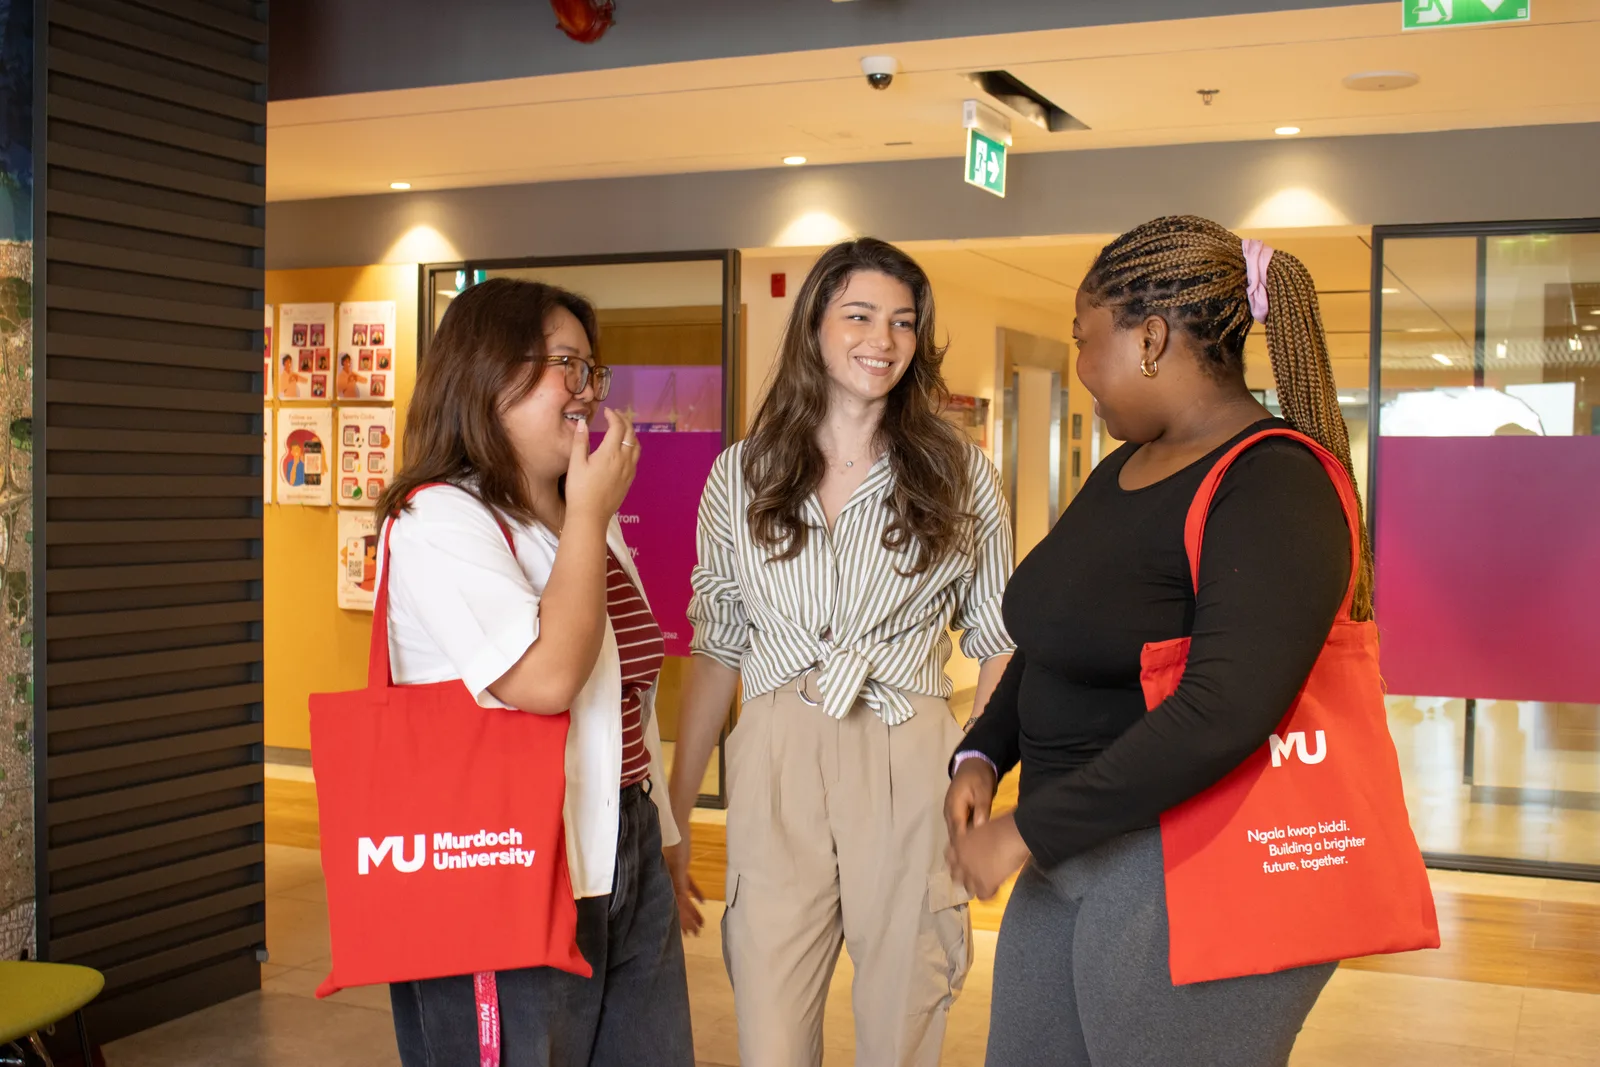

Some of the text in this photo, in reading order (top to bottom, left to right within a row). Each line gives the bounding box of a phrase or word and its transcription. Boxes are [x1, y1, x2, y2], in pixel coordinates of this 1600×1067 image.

[615, 512, 640, 524] from
[1269, 730, 1327, 768] MU
[433, 828, 523, 850] Murdoch
[1247, 820, 1350, 844] Ngala kwop biddi.
[358, 834, 426, 875] MU
[1269, 836, 1366, 856] Building a brighter
[433, 847, 535, 870] University
[1262, 854, 1348, 873] future, together.
